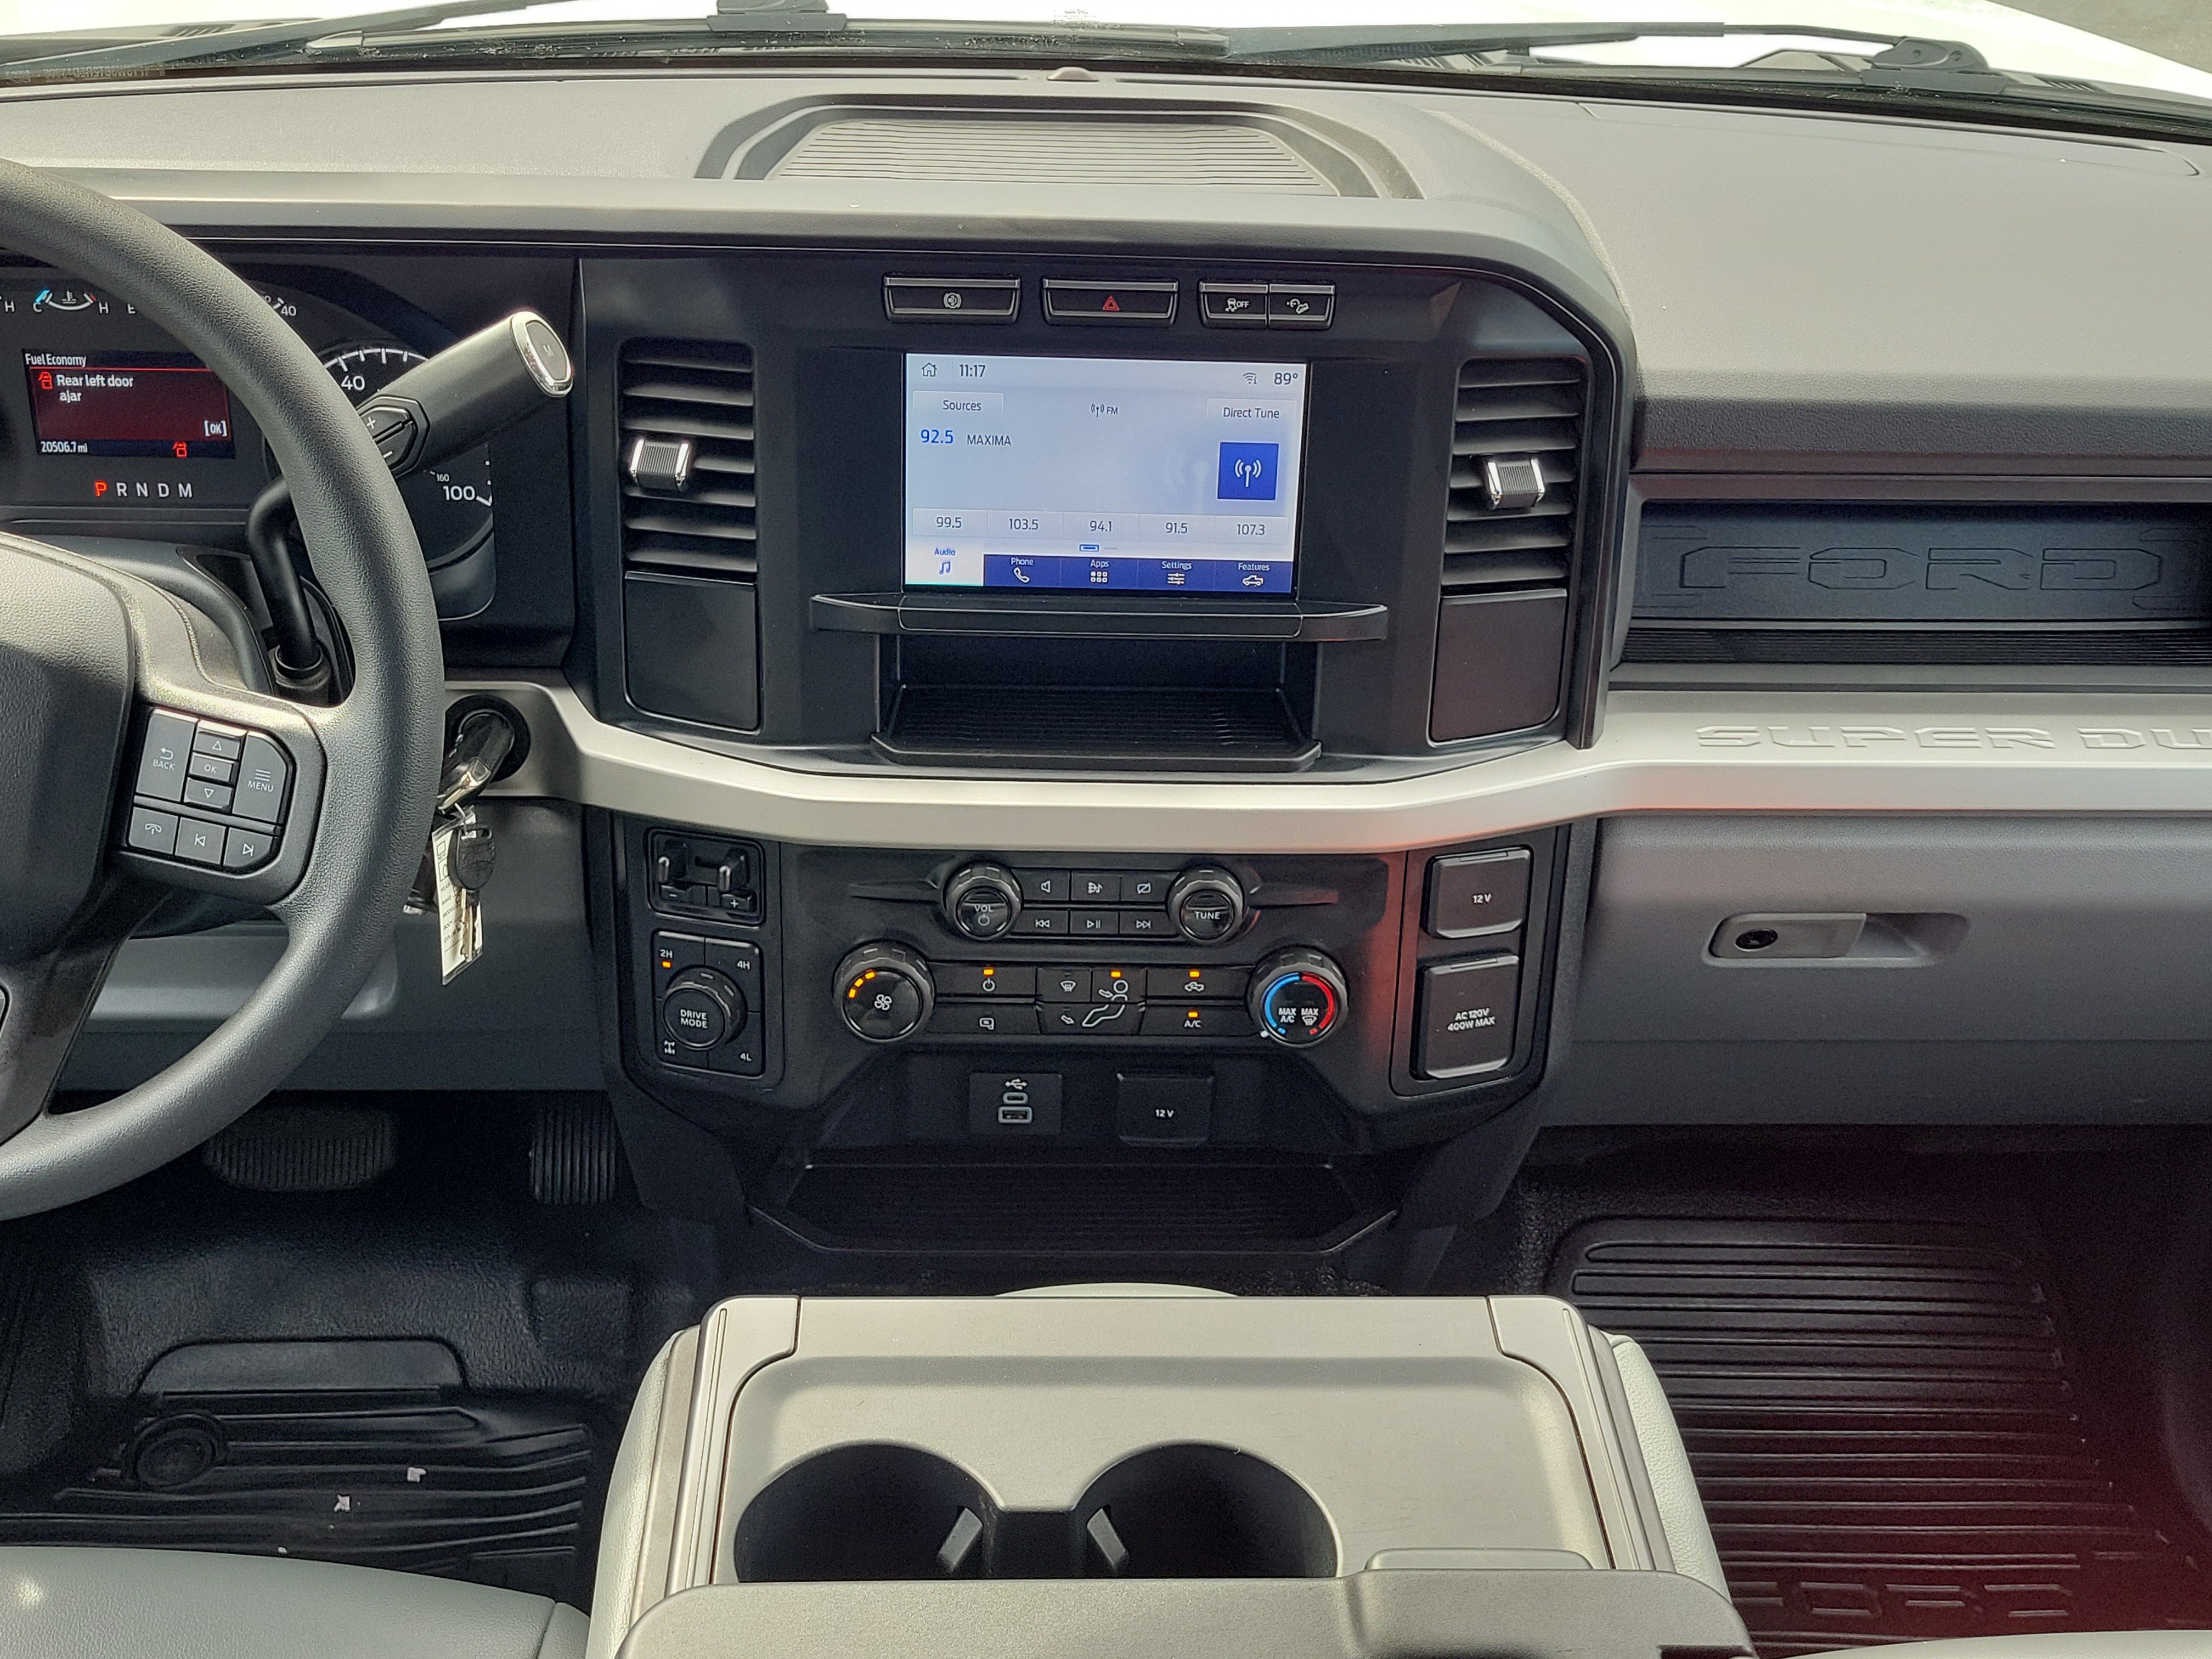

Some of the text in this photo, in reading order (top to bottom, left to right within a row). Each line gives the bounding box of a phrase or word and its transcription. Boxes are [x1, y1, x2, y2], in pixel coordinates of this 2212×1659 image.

[4, 301, 15, 312] H
[33, 302, 42, 313] C
[99, 302, 109, 313] H
[281, 305, 296, 317] 40
[25, 354, 87, 368] Fuel Economy
[960, 364, 986, 377] 11:17
[57, 375, 134, 387] Rear left door
[341, 375, 365, 391] 40
[1273, 373, 1299, 385] 89°
[59, 391, 82, 403] ajar
[943, 400, 982, 411] Sources
[1223, 408, 1280, 419] Direct Tune
[921, 429, 1012, 446] 92.5 MAXIMA
[41, 441, 87, 453] 20506.7 mi
[436, 473, 450, 482] 160
[94, 481, 193, 498] P R N D M
[443, 486, 476, 500] 100
[936, 516, 962, 528] 99.5
[1008, 518, 1039, 530] 103.5
[1090, 521, 1112, 532] 94.1
[1165, 522, 1188, 533] 91.5
[1237, 524, 1265, 535] 107.3
[1011, 557, 1034, 566] Phone
[1090, 559, 1109, 568] Apps
[1161, 561, 1192, 571] Settings
[1238, 562, 1270, 572] Features
[1679, 546, 2163, 590] FORD
[1696, 725, 2056, 749] SUPER
[153, 759, 175, 770] BACK
[204, 764, 217, 774] OK
[247, 780, 274, 792] MENU
[1194, 911, 1220, 920] TUNE
[660, 950, 673, 958] 2H
[737, 961, 751, 970] 4H
[680, 1009, 707, 1020] DRIVE
[1454, 1007, 1489, 1020] AC 120V
[681, 1018, 708, 1029] MODE
[1184, 1020, 1201, 1028] A/C
[1447, 1016, 1496, 1031] 400W MAX
[740, 1053, 752, 1062] 4L
